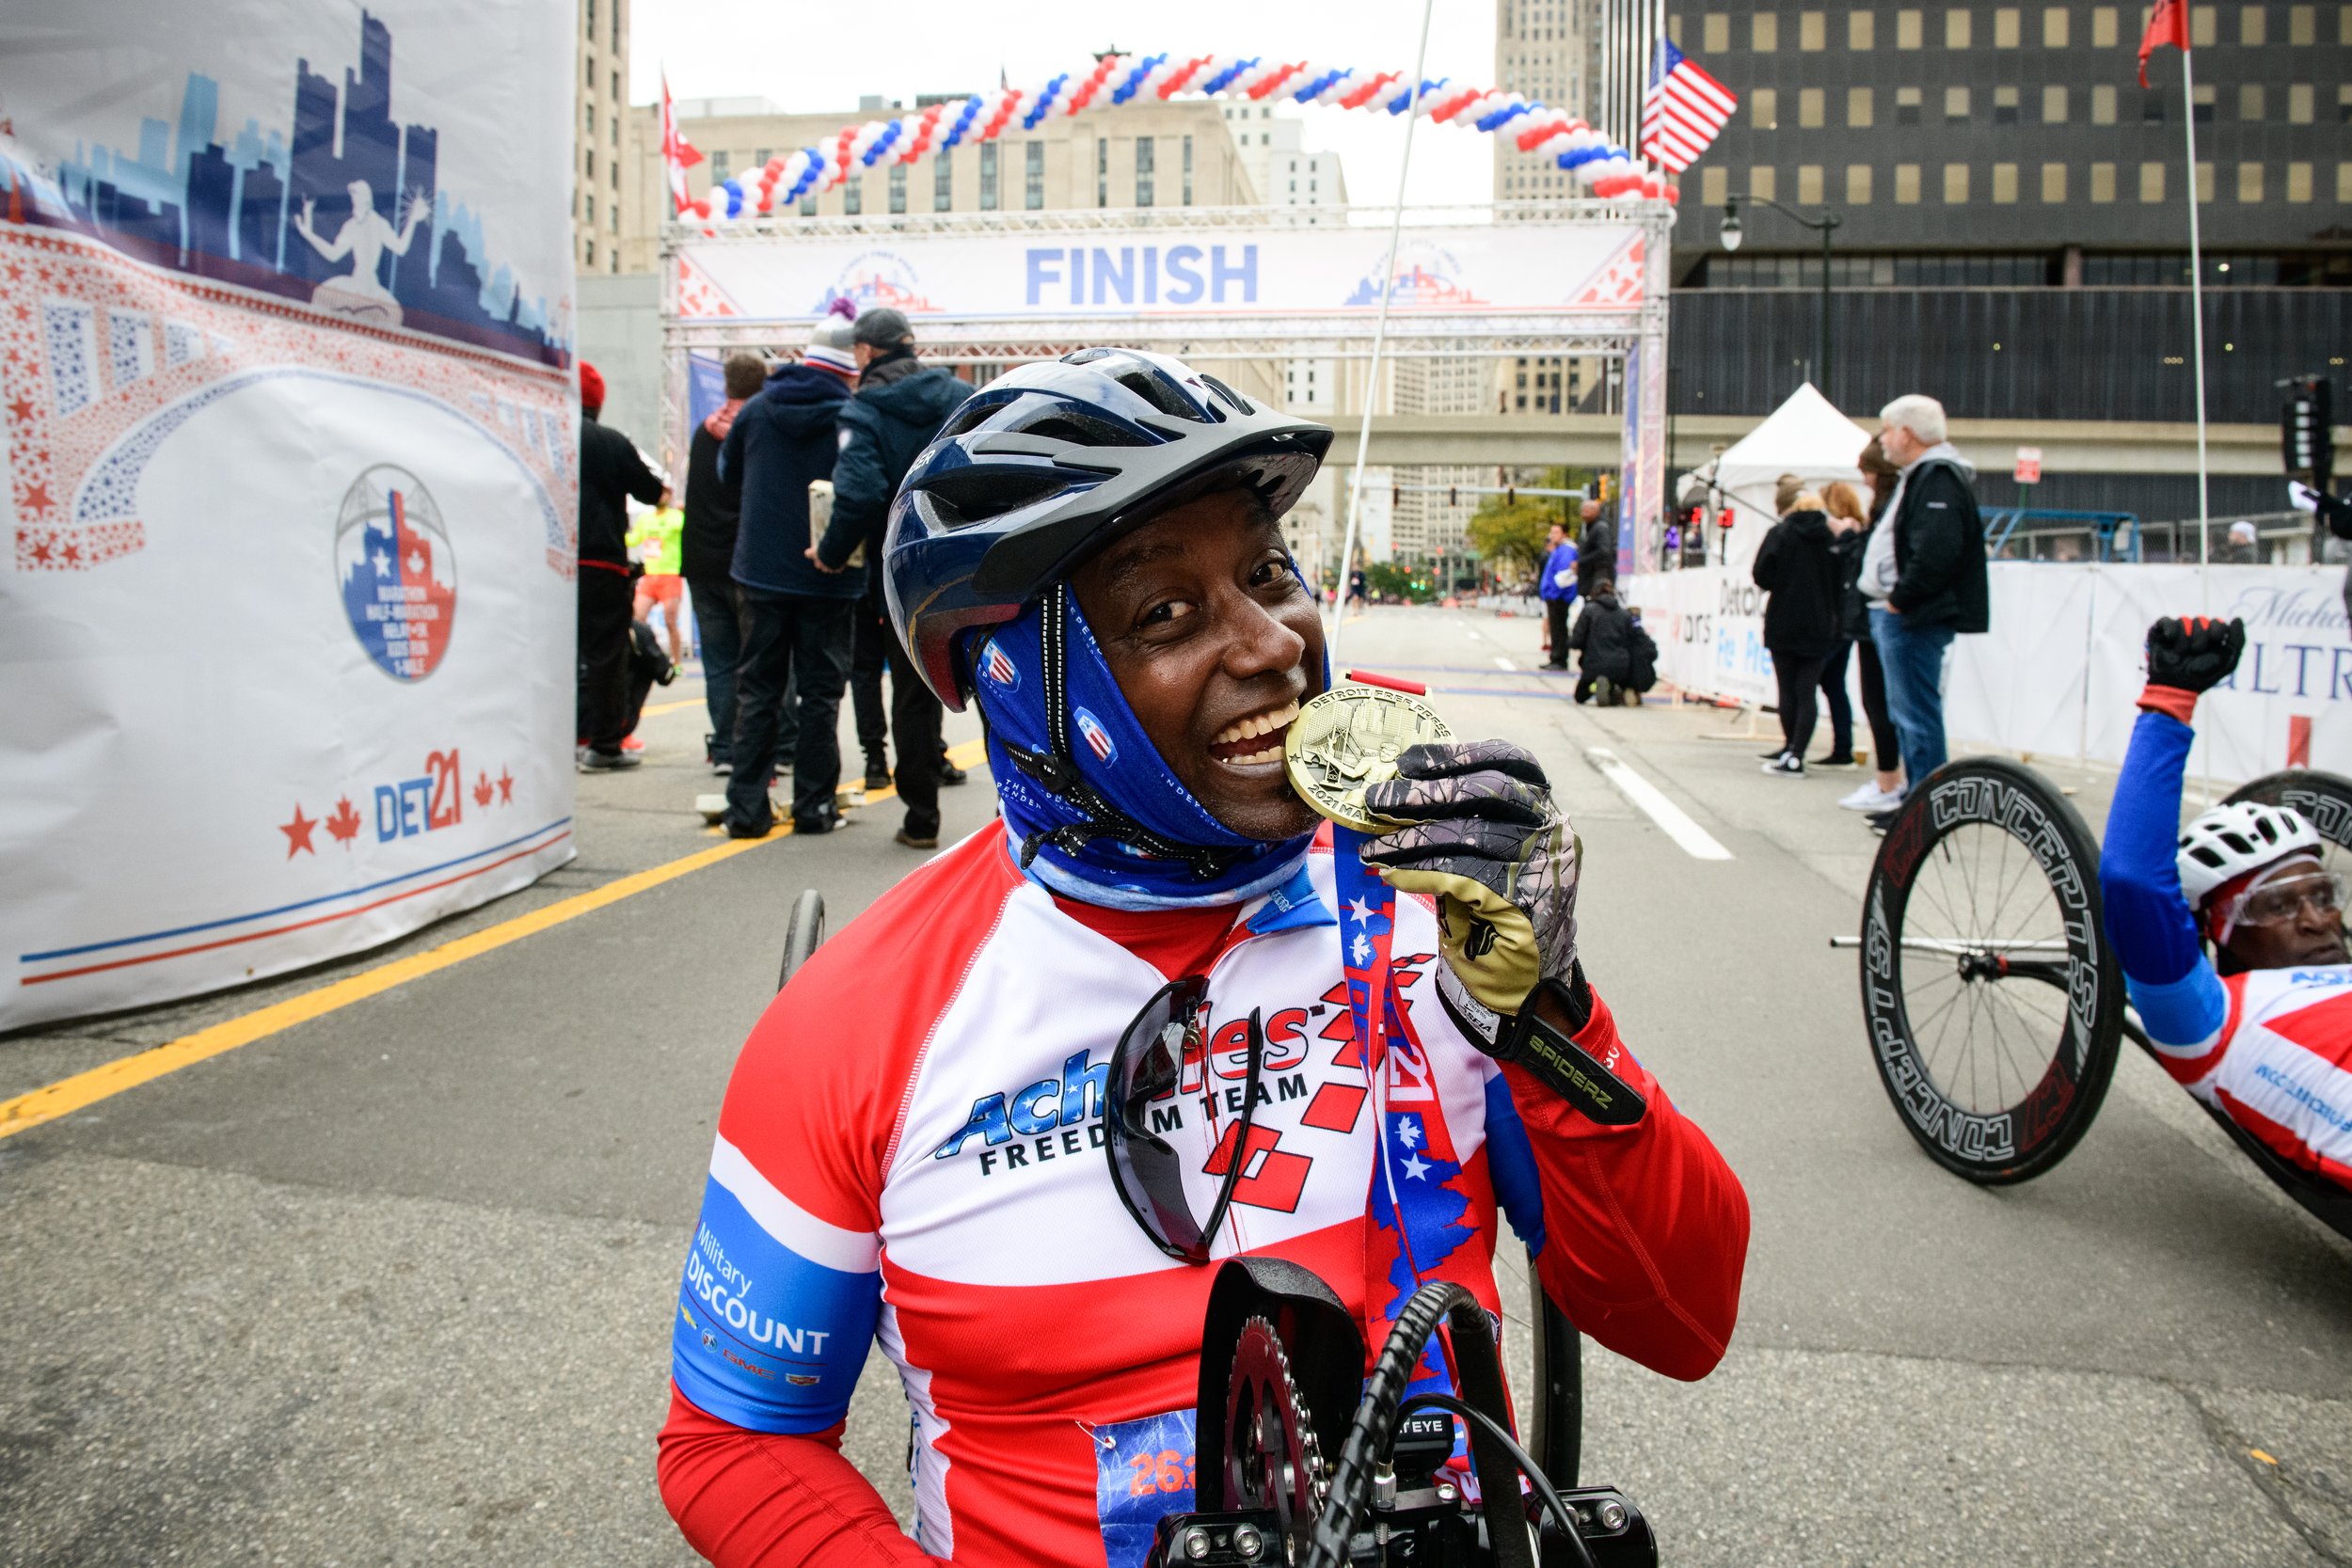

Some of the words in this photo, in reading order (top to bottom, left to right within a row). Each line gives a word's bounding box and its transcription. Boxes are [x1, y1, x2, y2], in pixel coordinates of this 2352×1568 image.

[1026, 245, 1258, 306] FINISH
[1311, 688, 1370, 709] DETROIT
[1375, 689, 1413, 707] FREE
[1413, 704, 1452, 738] PRESS
[1005, 778, 1027, 794] THE
[1308, 784, 1339, 809] 2021
[1529, 1034, 1613, 1111] SPIDERZ
[978, 1106, 1184, 1176] FREEDM
[1199, 1072, 1310, 1132] TEAM
[698, 1222, 753, 1298] Military
[688, 1250, 830, 1355] DISCOUNT
[723, 1349, 776, 1380] GMC
